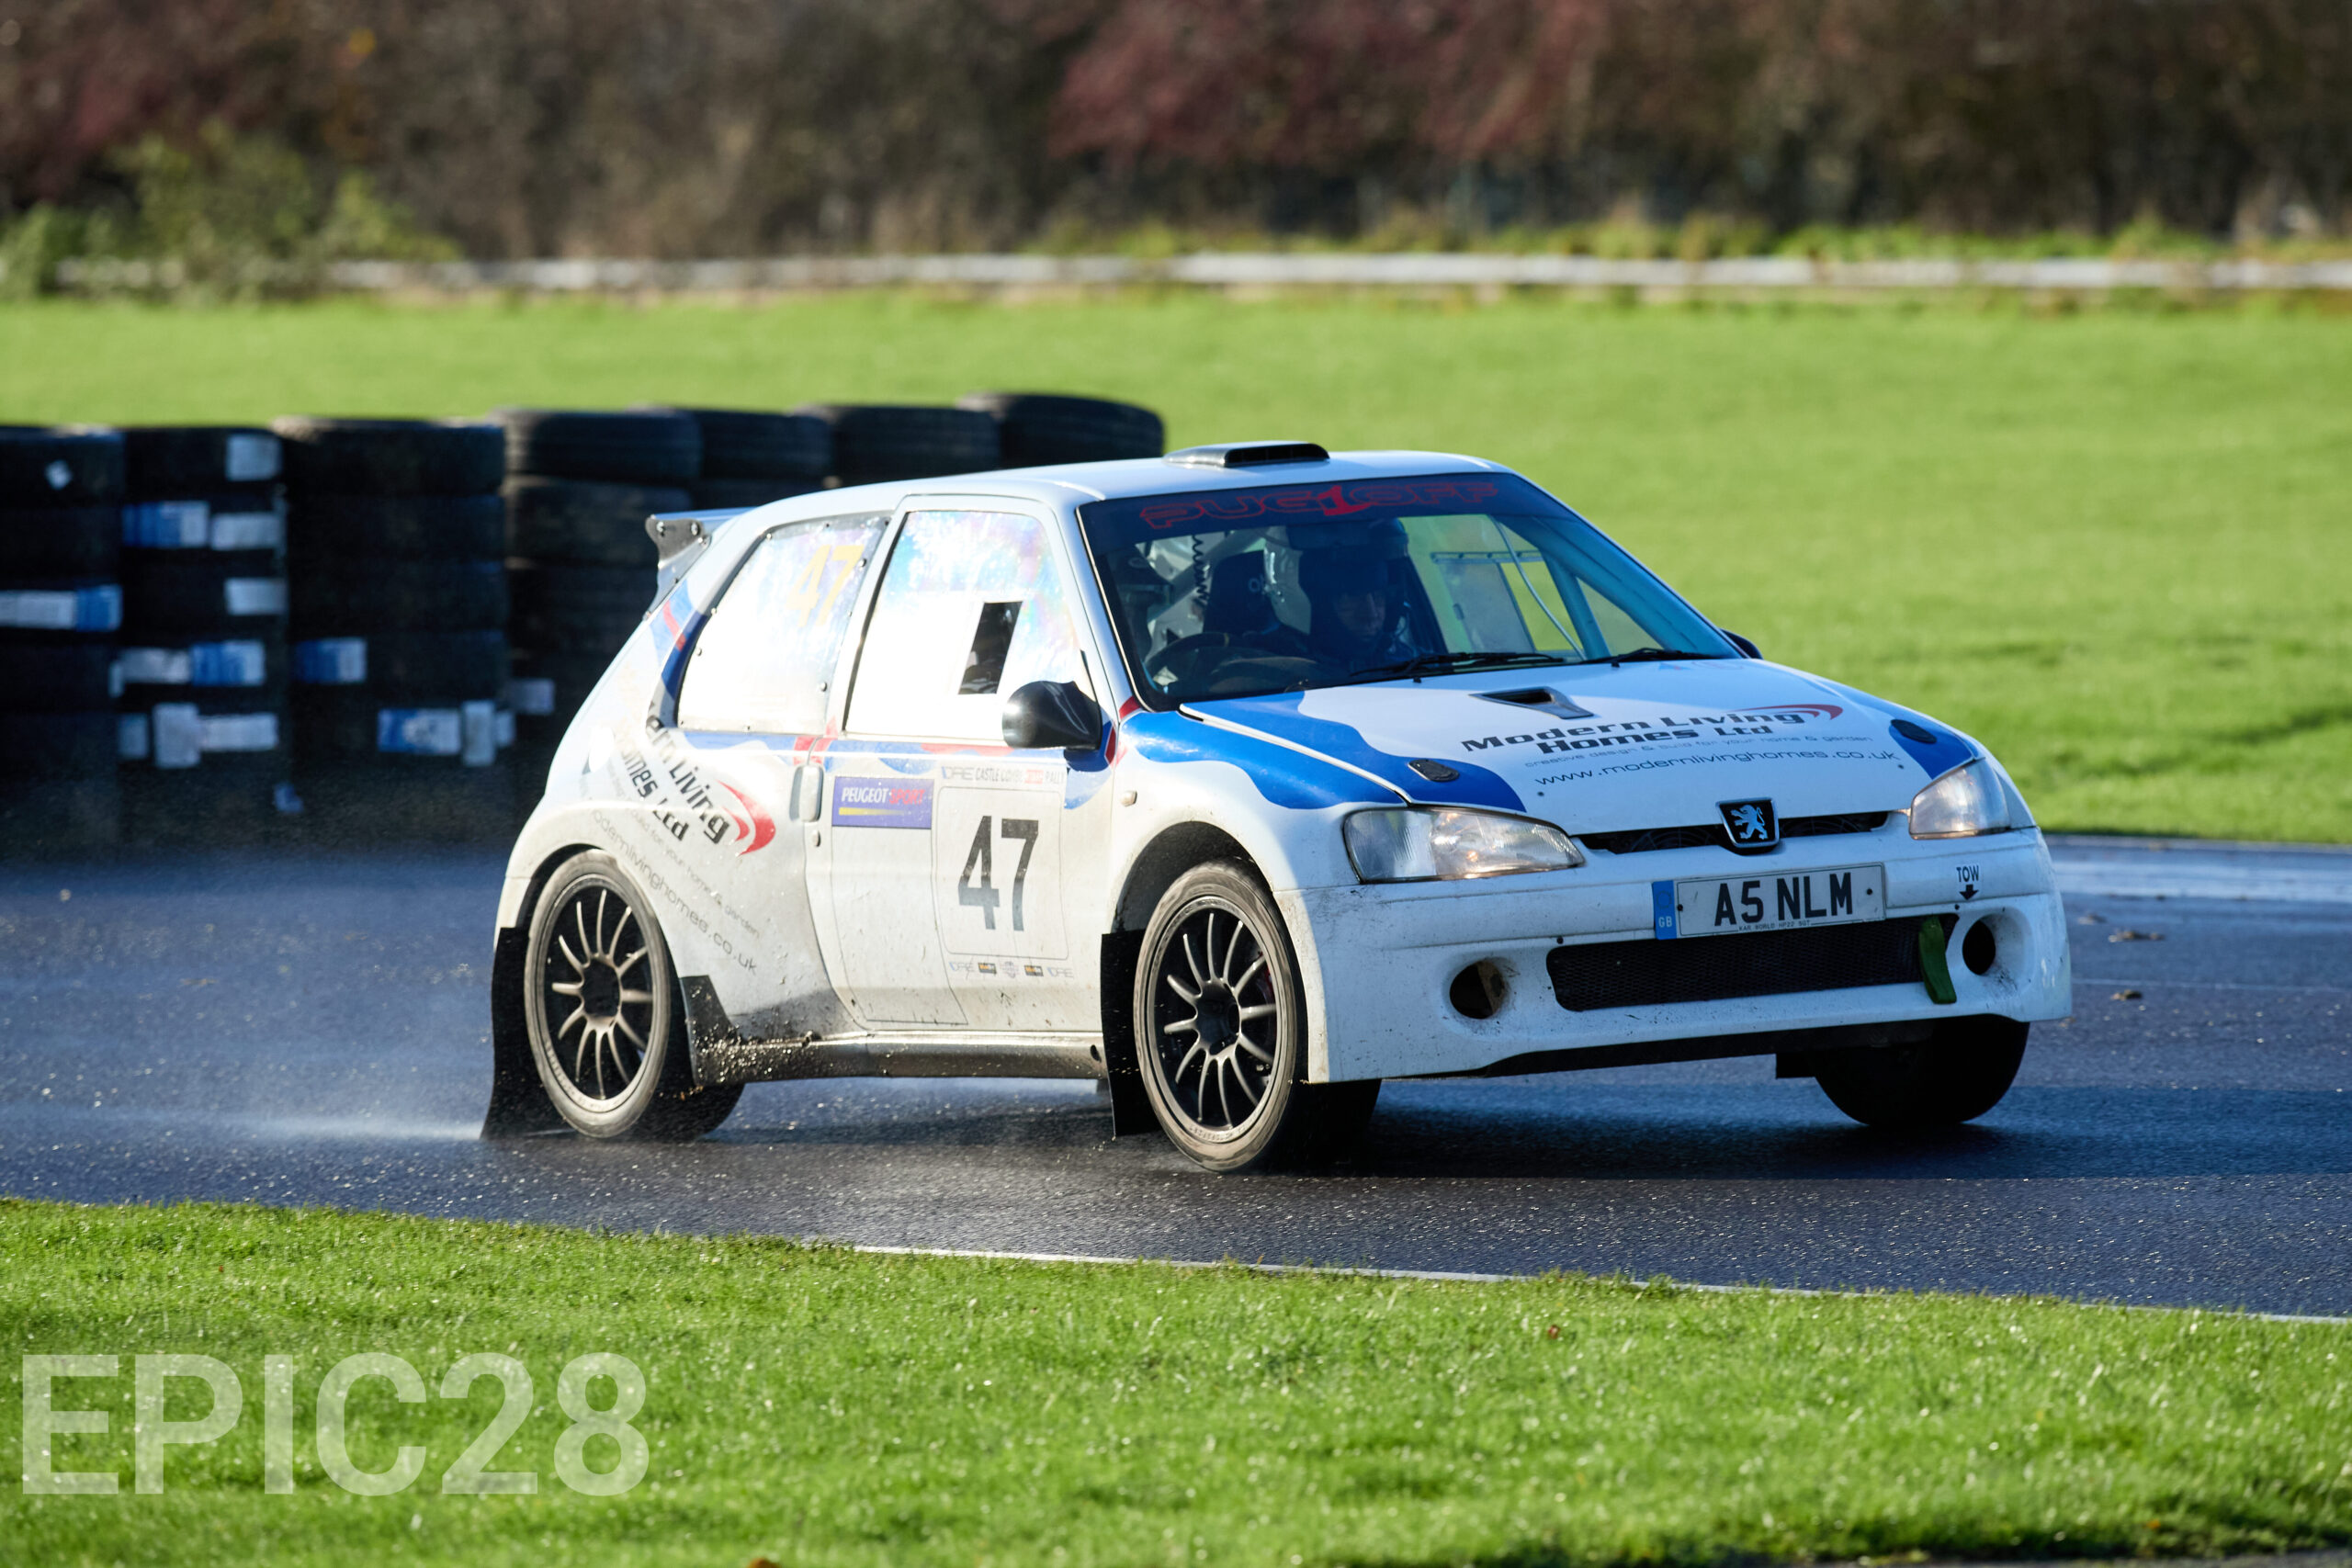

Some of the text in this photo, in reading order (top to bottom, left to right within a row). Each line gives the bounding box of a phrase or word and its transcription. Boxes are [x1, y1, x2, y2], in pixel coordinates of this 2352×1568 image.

[785, 544, 865, 628] 47
[1461, 713, 1805, 752] Modern Living
[1535, 726, 1774, 754] Homes Ltd
[1524, 754, 1586, 768] creative
[1589, 746, 1635, 759] design
[1534, 750, 1901, 786] www.modernlivinghomes.co.uk
[841, 786, 926, 806] PEUGEOT SPORT
[957, 815, 1039, 932] 47
[1955, 863, 1980, 883] TOW
[1713, 872, 1853, 927] A5 NLM
[1658, 915, 1673, 928] GB
